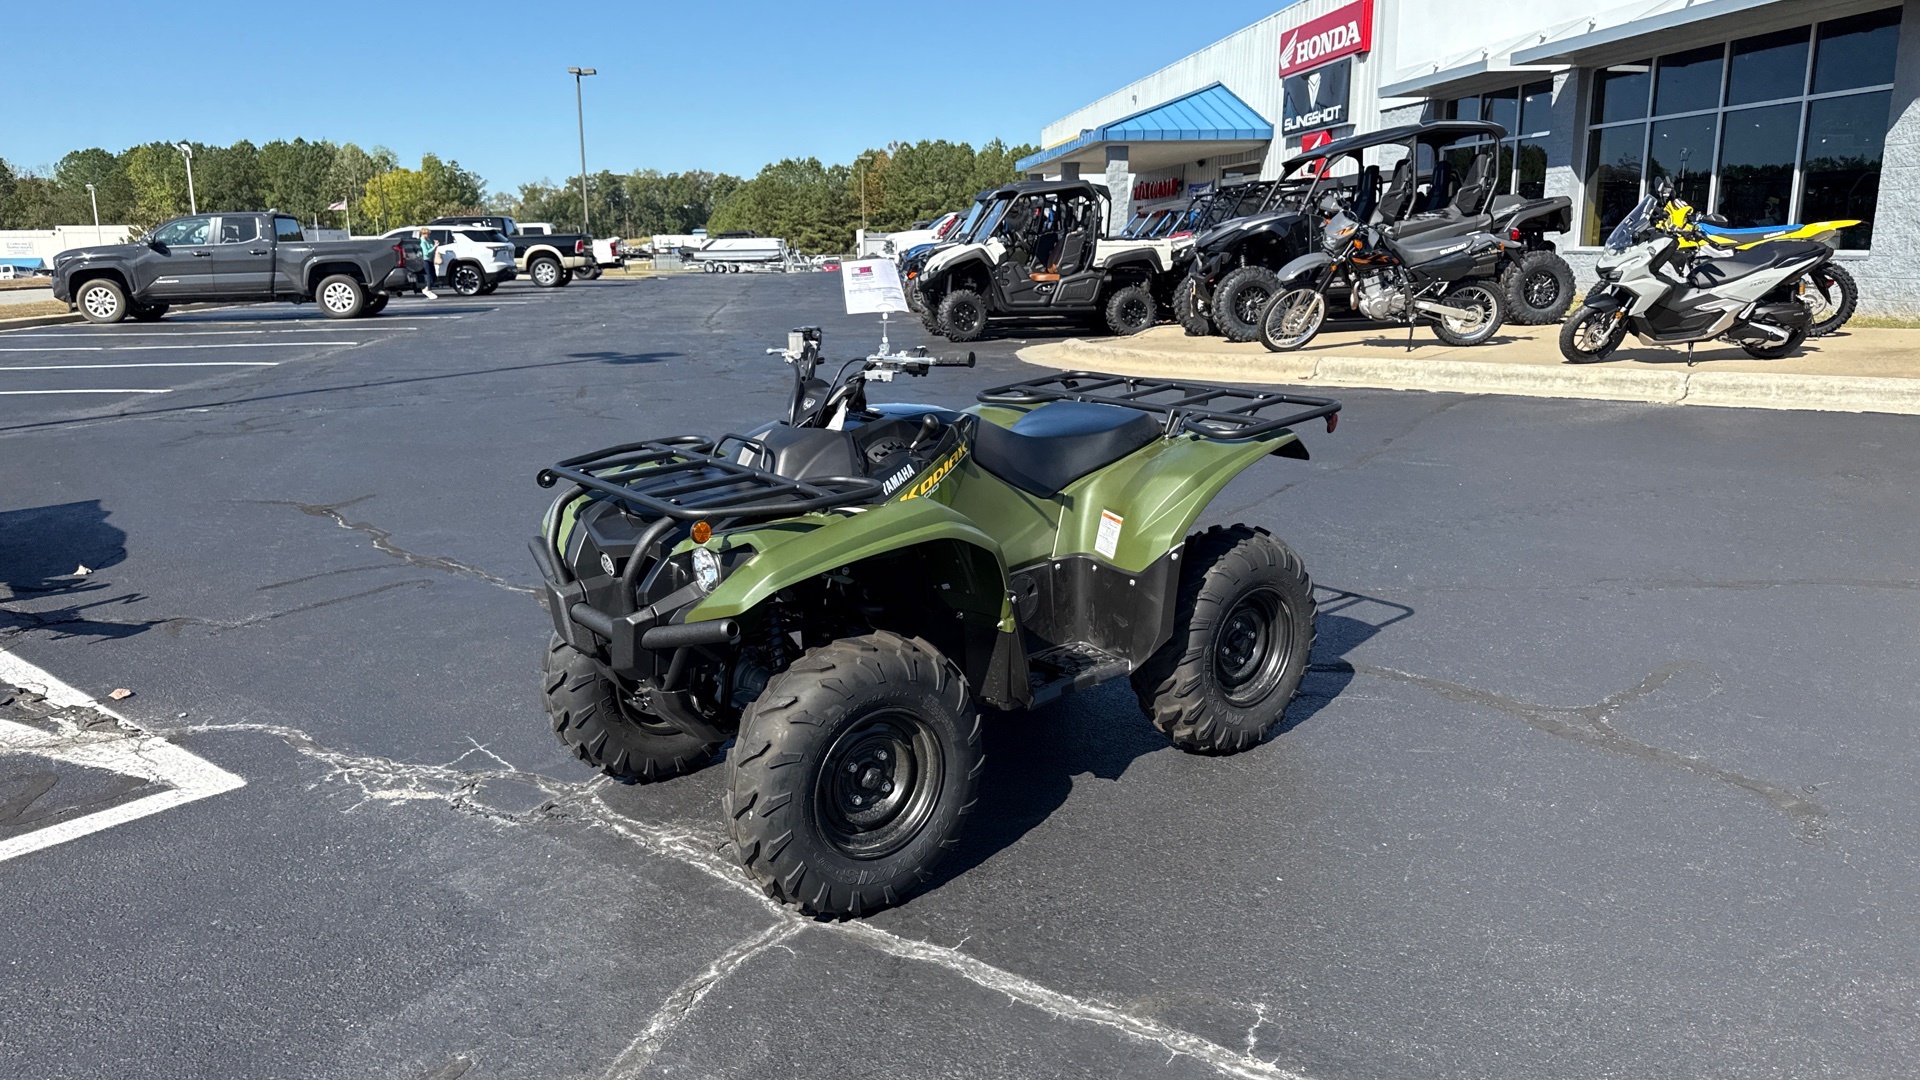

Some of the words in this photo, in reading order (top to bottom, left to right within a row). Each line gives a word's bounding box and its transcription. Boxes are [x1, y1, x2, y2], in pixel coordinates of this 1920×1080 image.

[1295, 20, 1361, 64] HONDA
[1284, 105, 1341, 131] SLINGSHOT
[882, 464, 915, 496] YAMAHA
[900, 441, 969, 501] KODIAK
